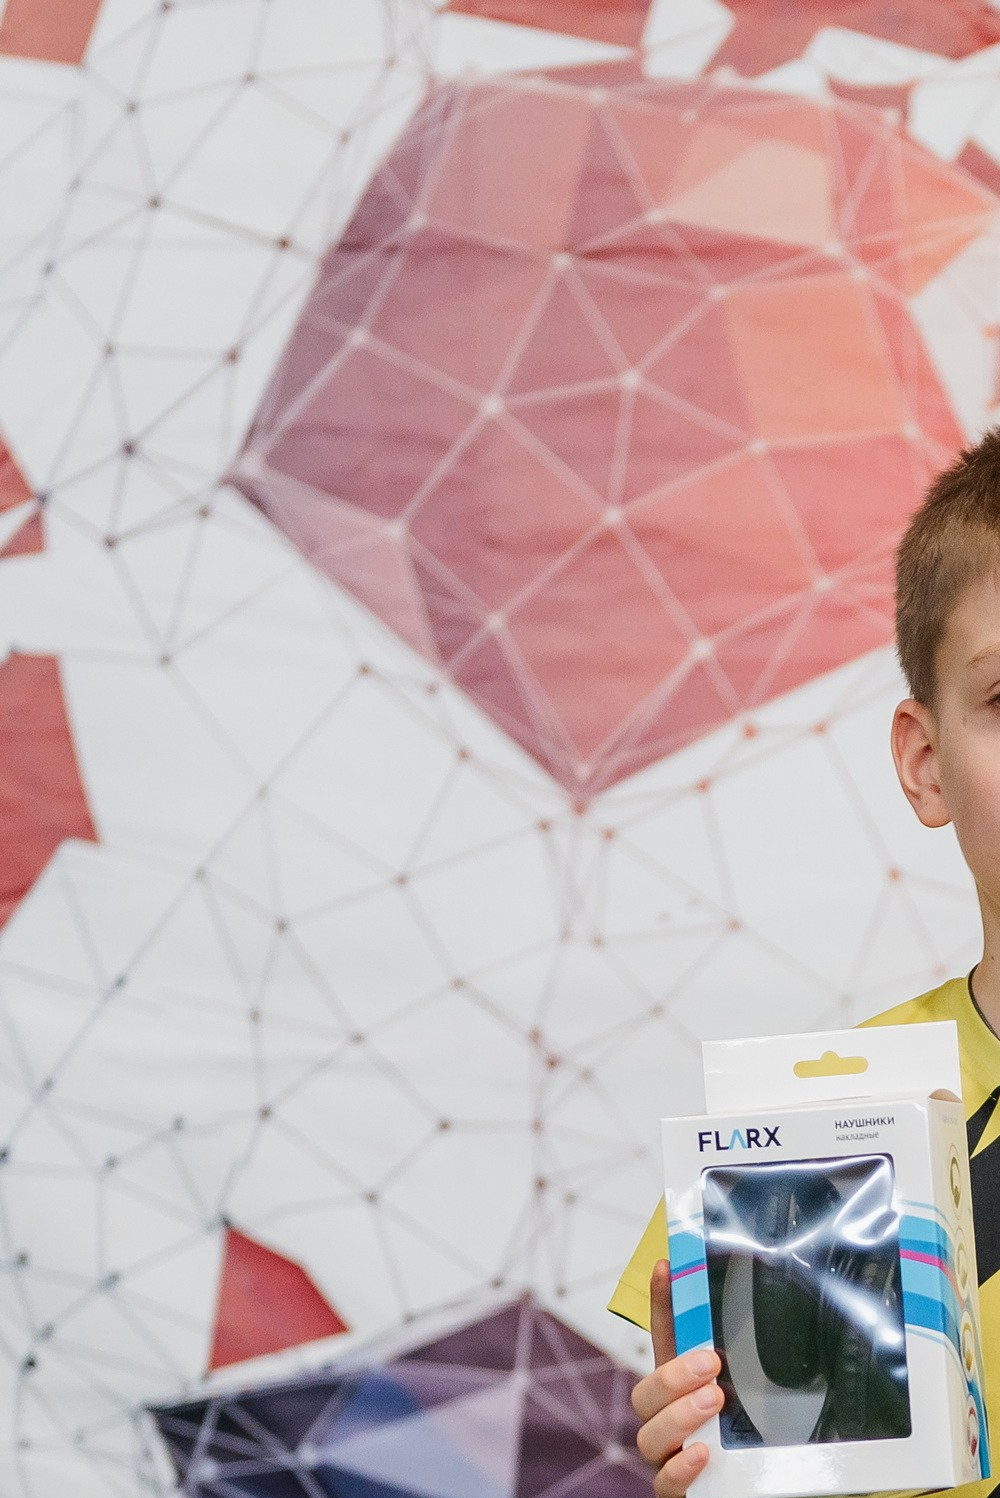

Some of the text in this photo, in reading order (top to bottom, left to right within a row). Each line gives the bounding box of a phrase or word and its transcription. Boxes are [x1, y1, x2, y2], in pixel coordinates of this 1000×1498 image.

[835, 1116, 895, 1130] НАУШНИКИ
[697, 1126, 782, 1152] FLARX
[835, 1132, 880, 1142] накладные
